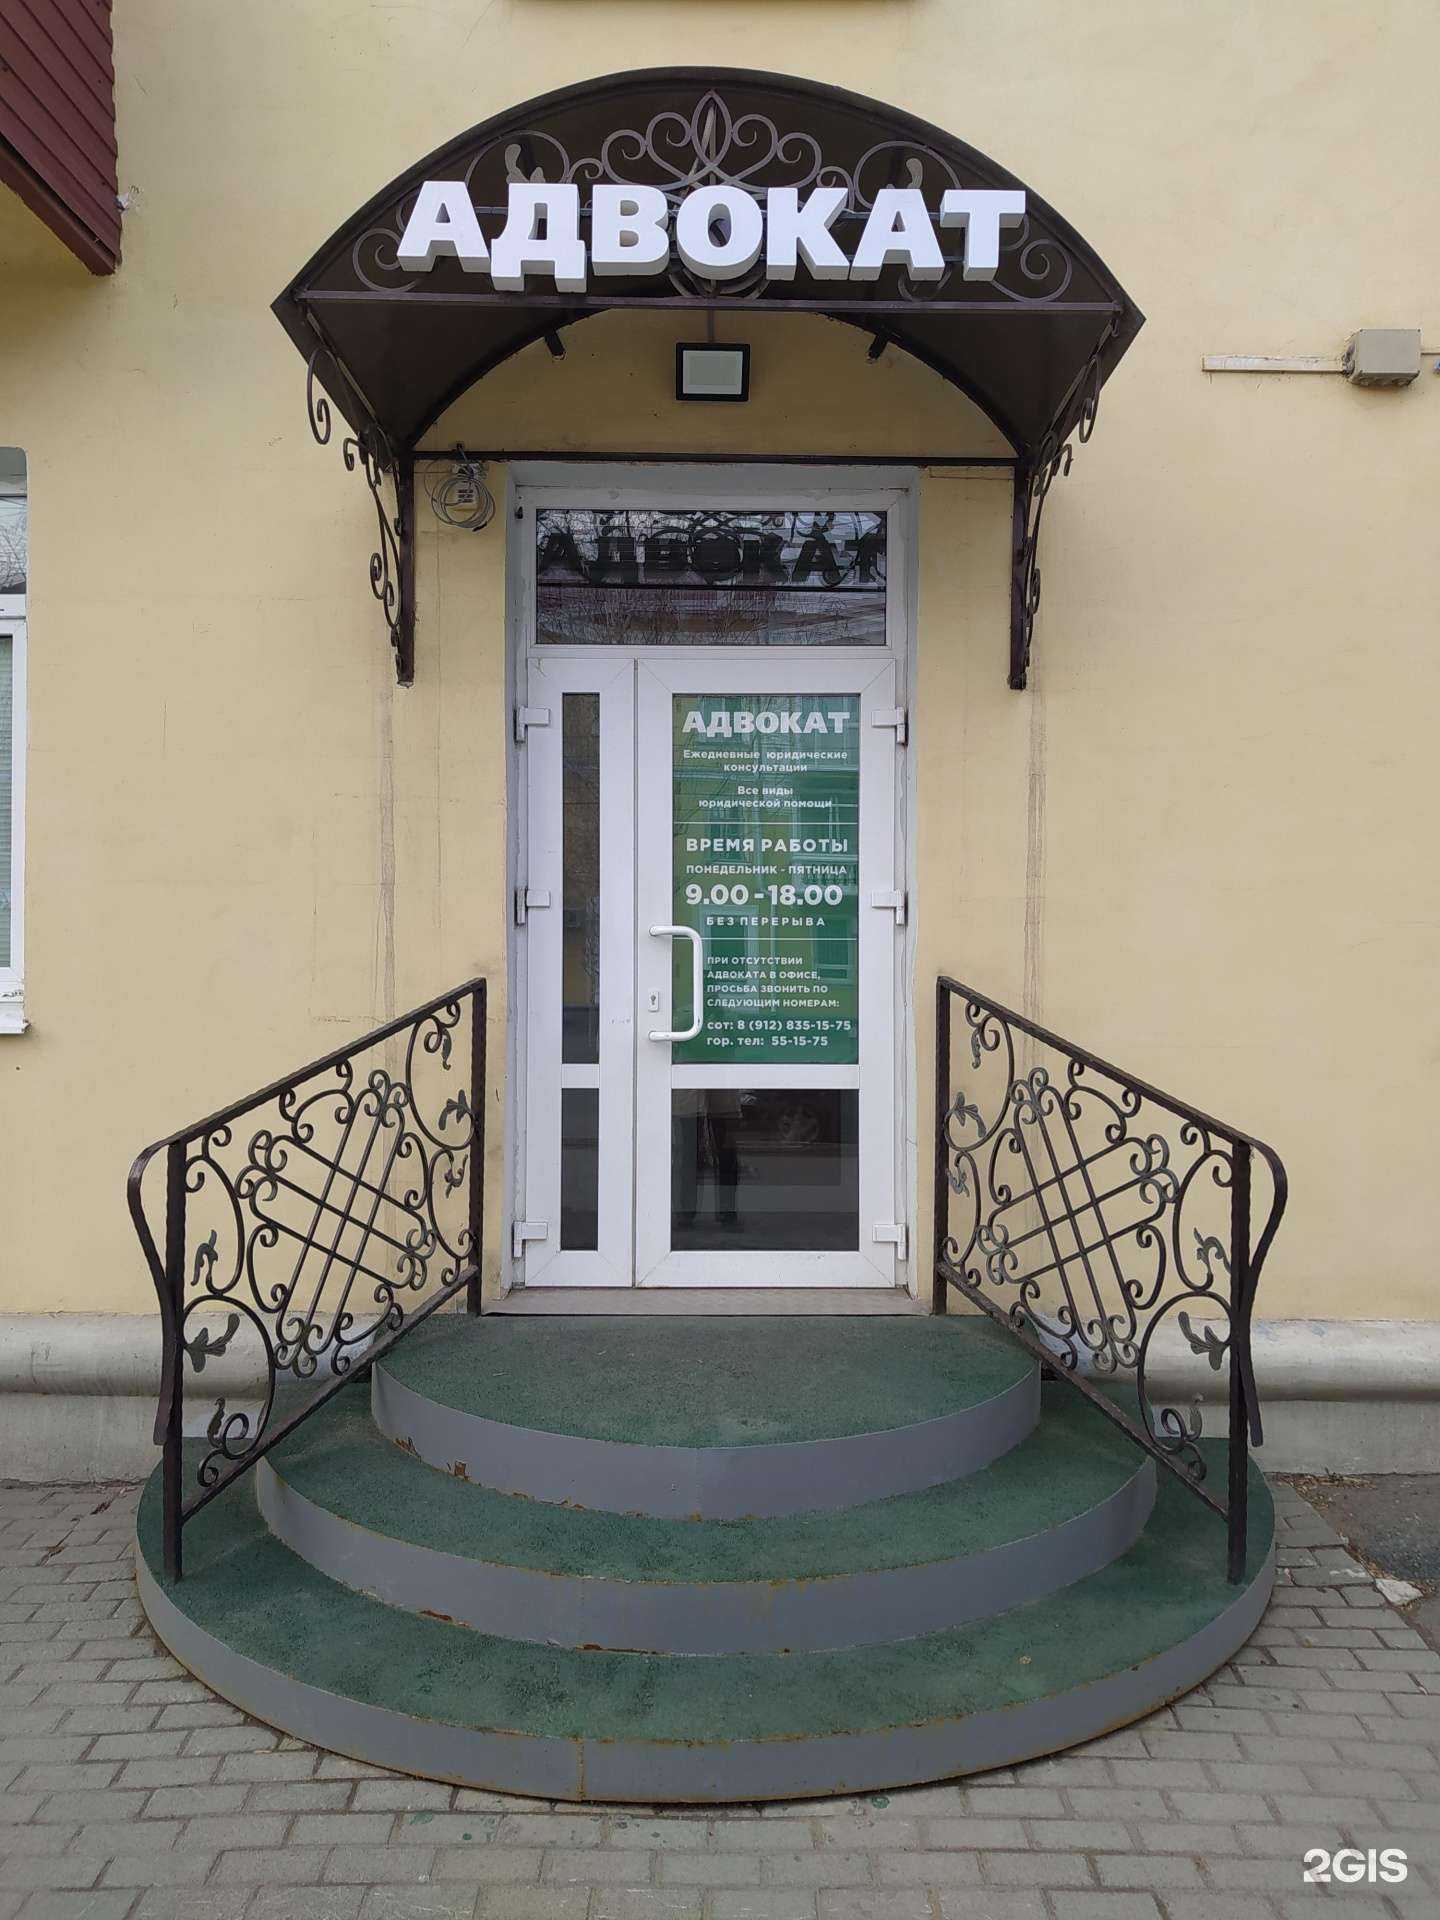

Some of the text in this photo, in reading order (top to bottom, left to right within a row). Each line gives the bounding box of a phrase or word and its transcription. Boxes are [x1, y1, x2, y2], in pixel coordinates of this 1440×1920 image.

[397, 180, 1026, 292] АДВОКАТ
[682, 712, 850, 738] АДВОКАТ
[684, 750, 847, 760] Ежедневные юридические
[724, 764, 807, 772] консультации
[738, 786, 793, 796] Все виды
[699, 799, 831, 808] юридической помощи
[686, 839, 848, 852] ВРЕМЯ РАБОТЫ
[686, 865, 777, 874] ПОНЕДЕЛЬНИК
[789, 865, 847, 875] ПЯТНИЦА
[685, 885, 749, 905] 9.00
[768, 885, 843, 905] 18.00
[707, 917, 825, 925] БЕЗ ПЕРЕРЫВА
[732, 957, 802, 965] ОТСУТСТВИИ
[707, 971, 766, 979] АДВОКАТА
[779, 971, 820, 980] ОФИСЕ,
[707, 985, 828, 993] ПРОСЬБА ЗВОНИТЬ ПО
[707, 999, 779, 1008] СЛЕДУЮЩИМ
[707, 1020, 851, 1031] сот: 8 (912) 835-15-75
[707, 1037, 828, 1047] гор. тел: 55-15-75
